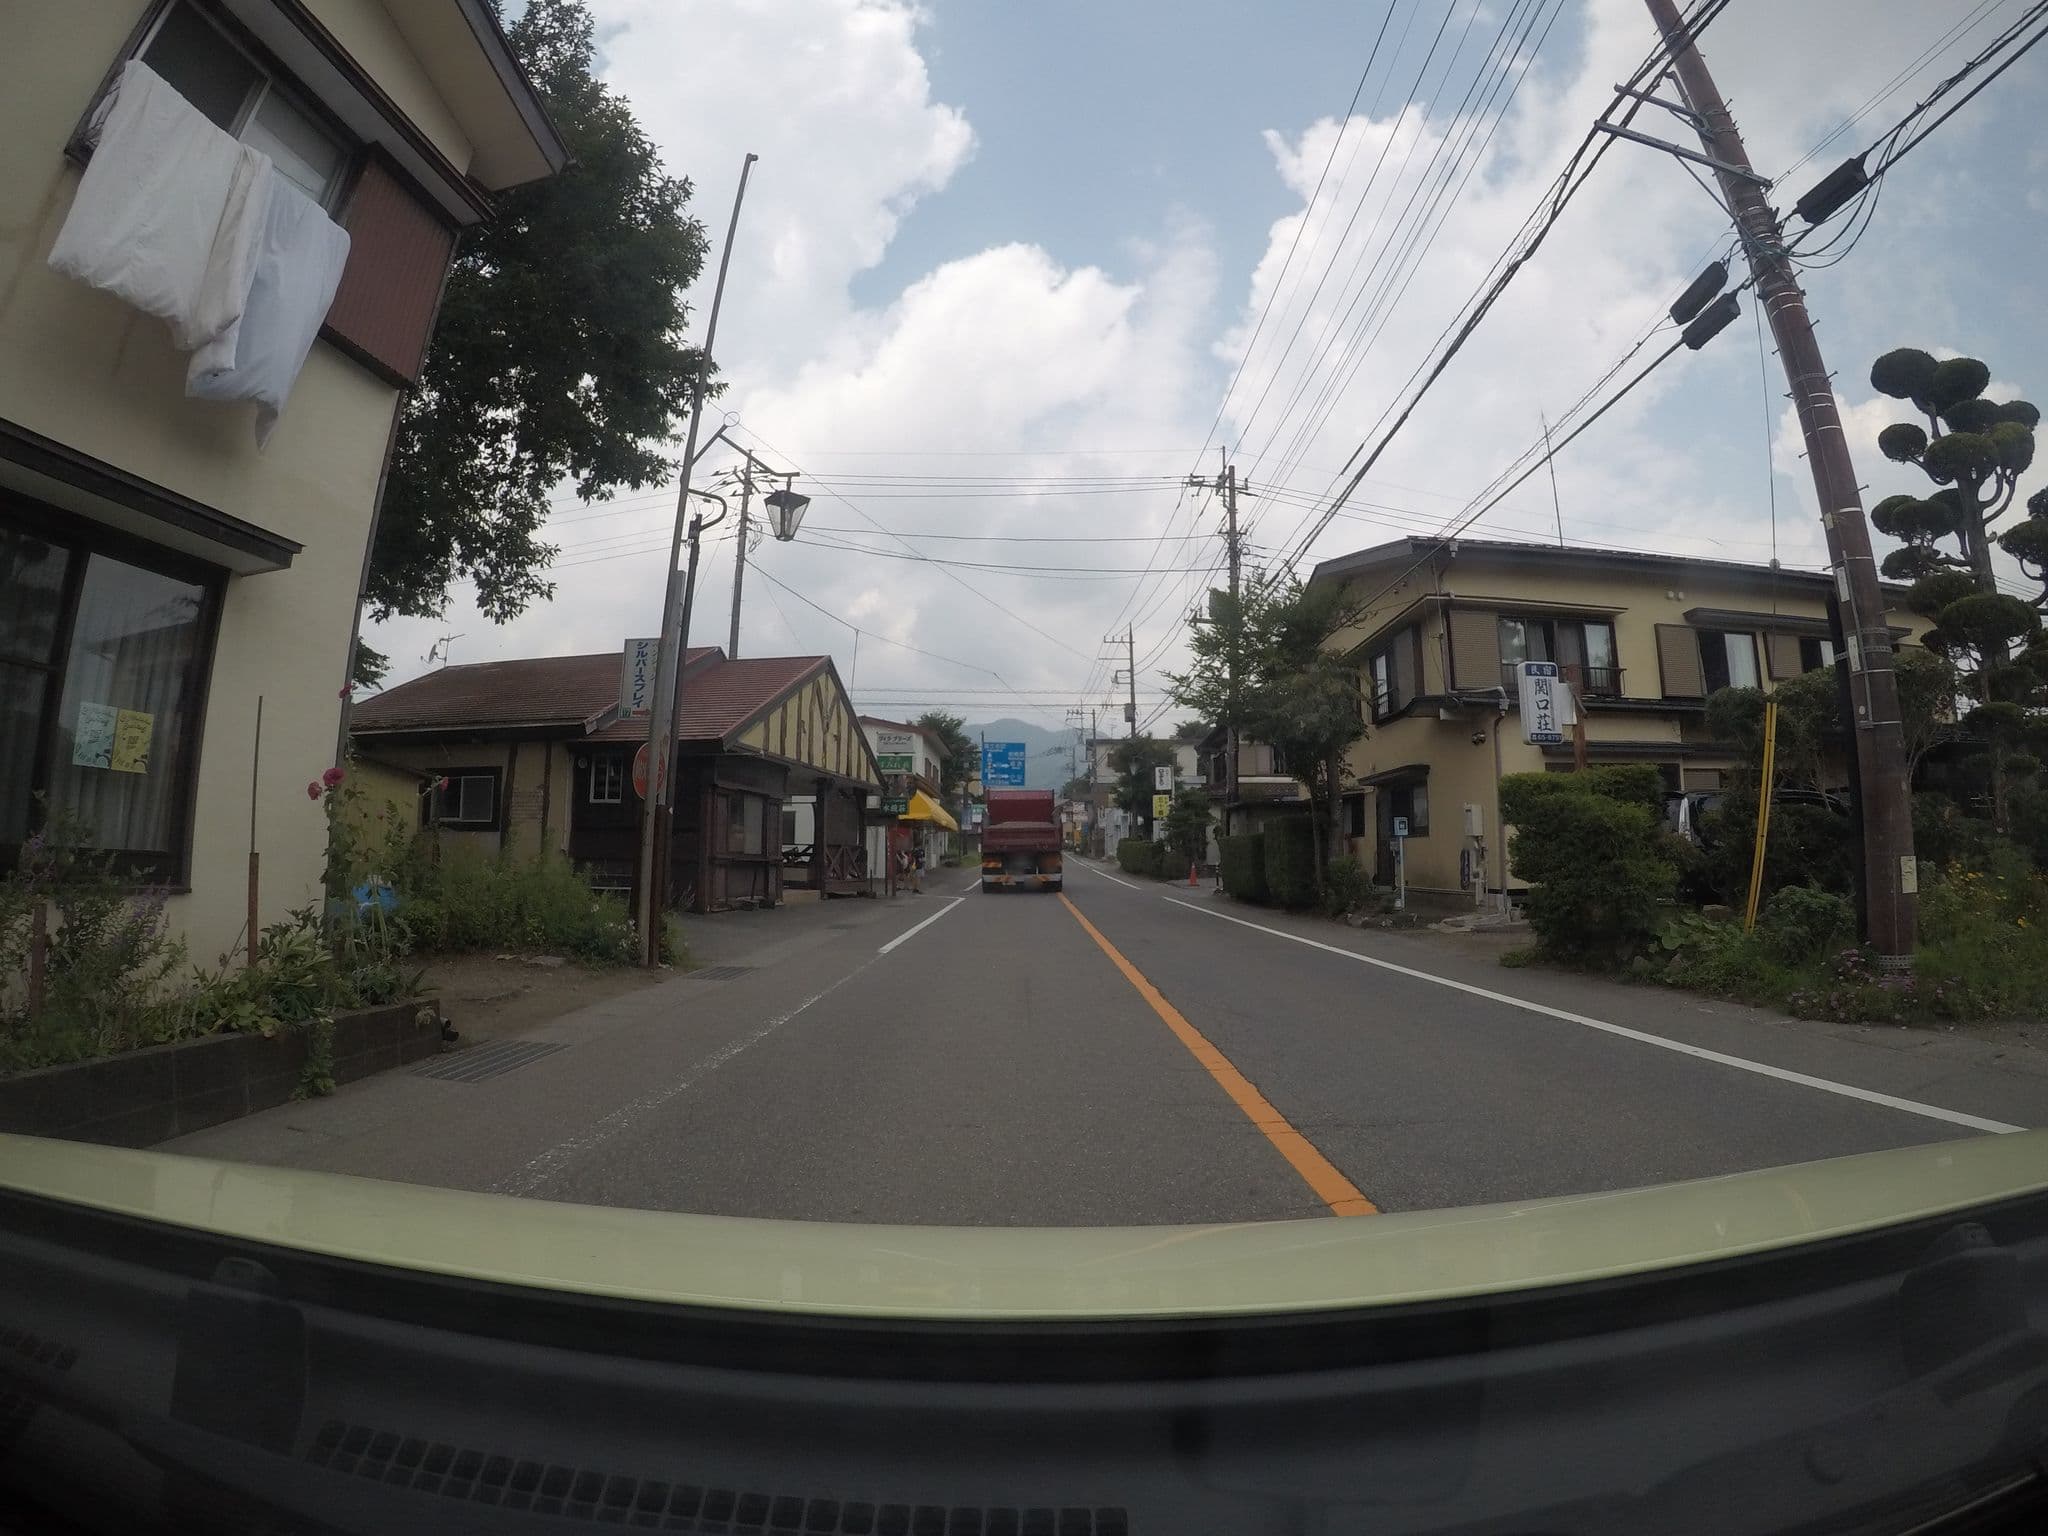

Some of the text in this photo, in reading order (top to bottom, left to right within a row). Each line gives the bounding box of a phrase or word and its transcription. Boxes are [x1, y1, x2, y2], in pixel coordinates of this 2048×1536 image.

[1531, 665, 1552, 676] 民宿
[1535, 678, 1552, 732] 関口荘
